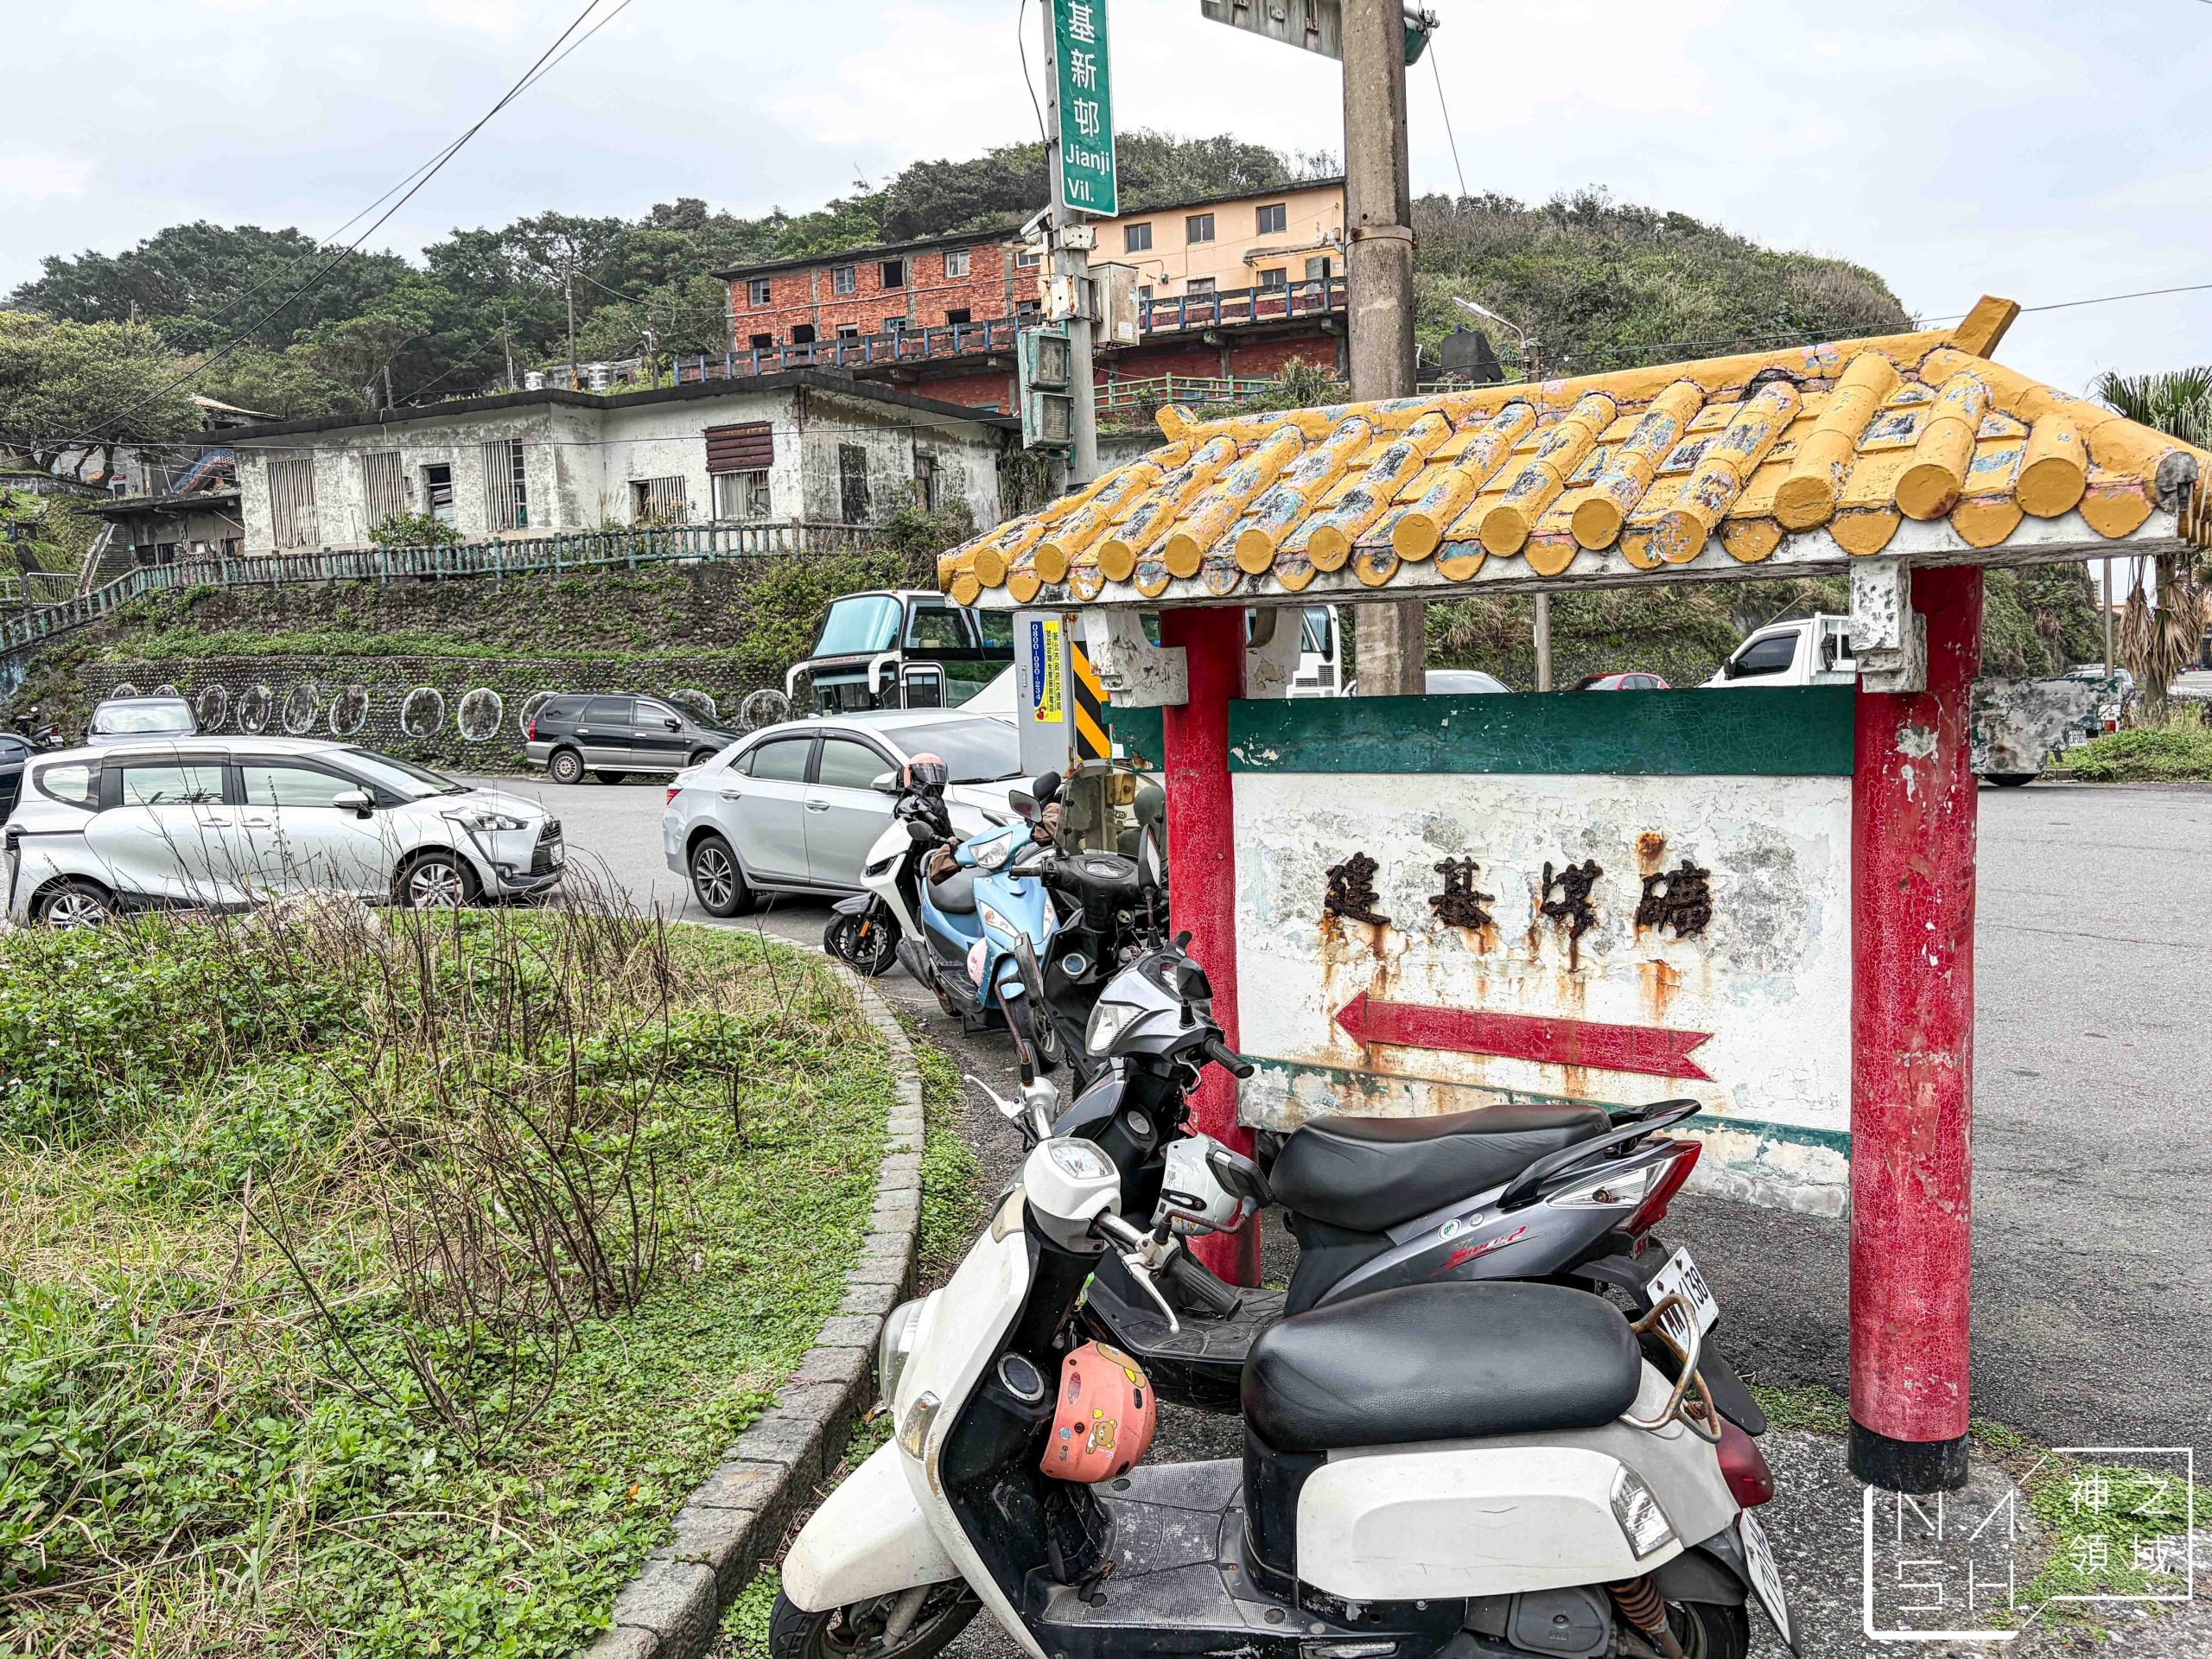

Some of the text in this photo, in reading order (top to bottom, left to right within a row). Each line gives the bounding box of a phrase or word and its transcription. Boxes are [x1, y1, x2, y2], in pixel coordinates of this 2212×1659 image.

[1068, 1, 1100, 137] 基新邨
[1065, 143, 1110, 175] Jianji
[1067, 177, 1095, 202] Vil.
[1032, 623, 1040, 700] 0800-090-234
[1325, 851, 1713, 938] 建基煤礦
